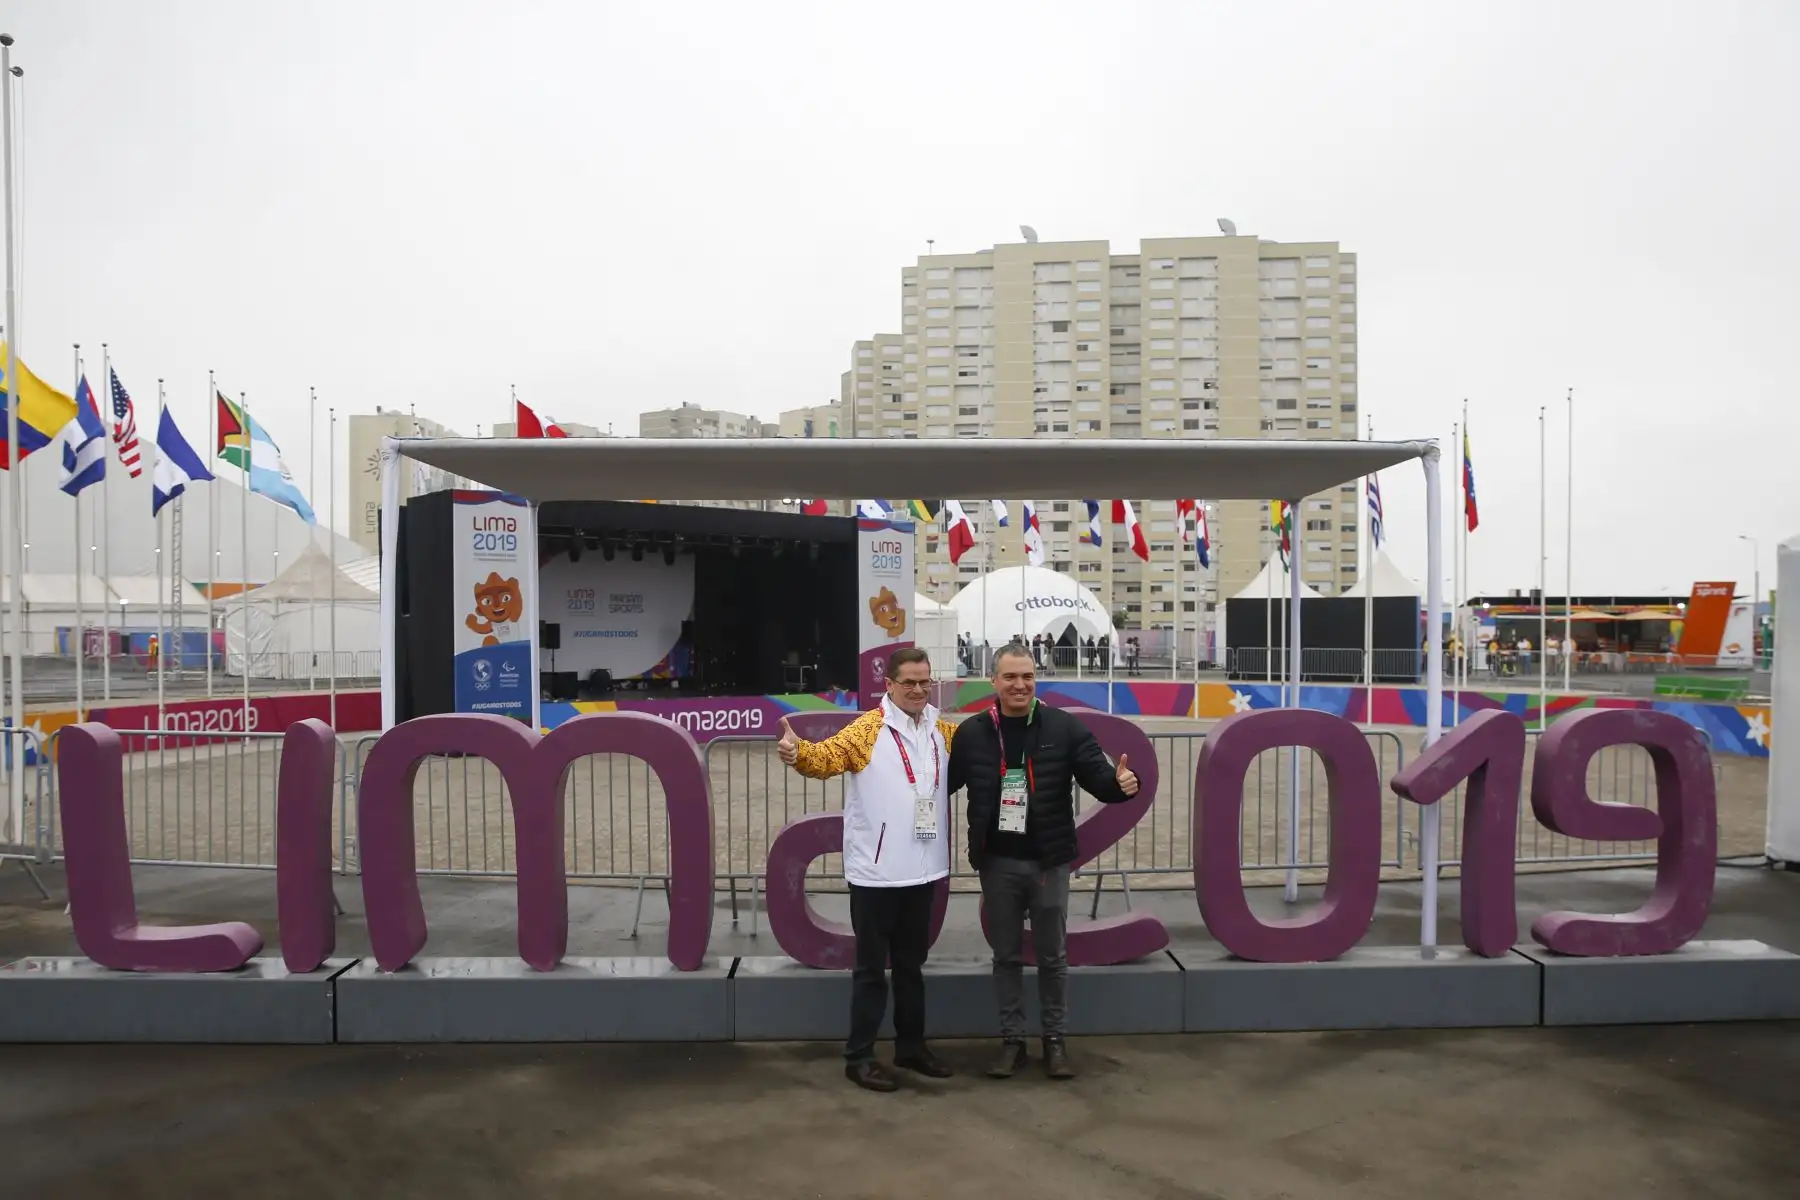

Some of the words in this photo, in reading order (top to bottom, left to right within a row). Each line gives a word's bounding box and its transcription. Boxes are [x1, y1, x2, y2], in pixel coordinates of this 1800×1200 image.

[473, 533, 517, 551] 2019
[871, 555, 902, 569] 2019
[567, 599, 595, 610] 2019
